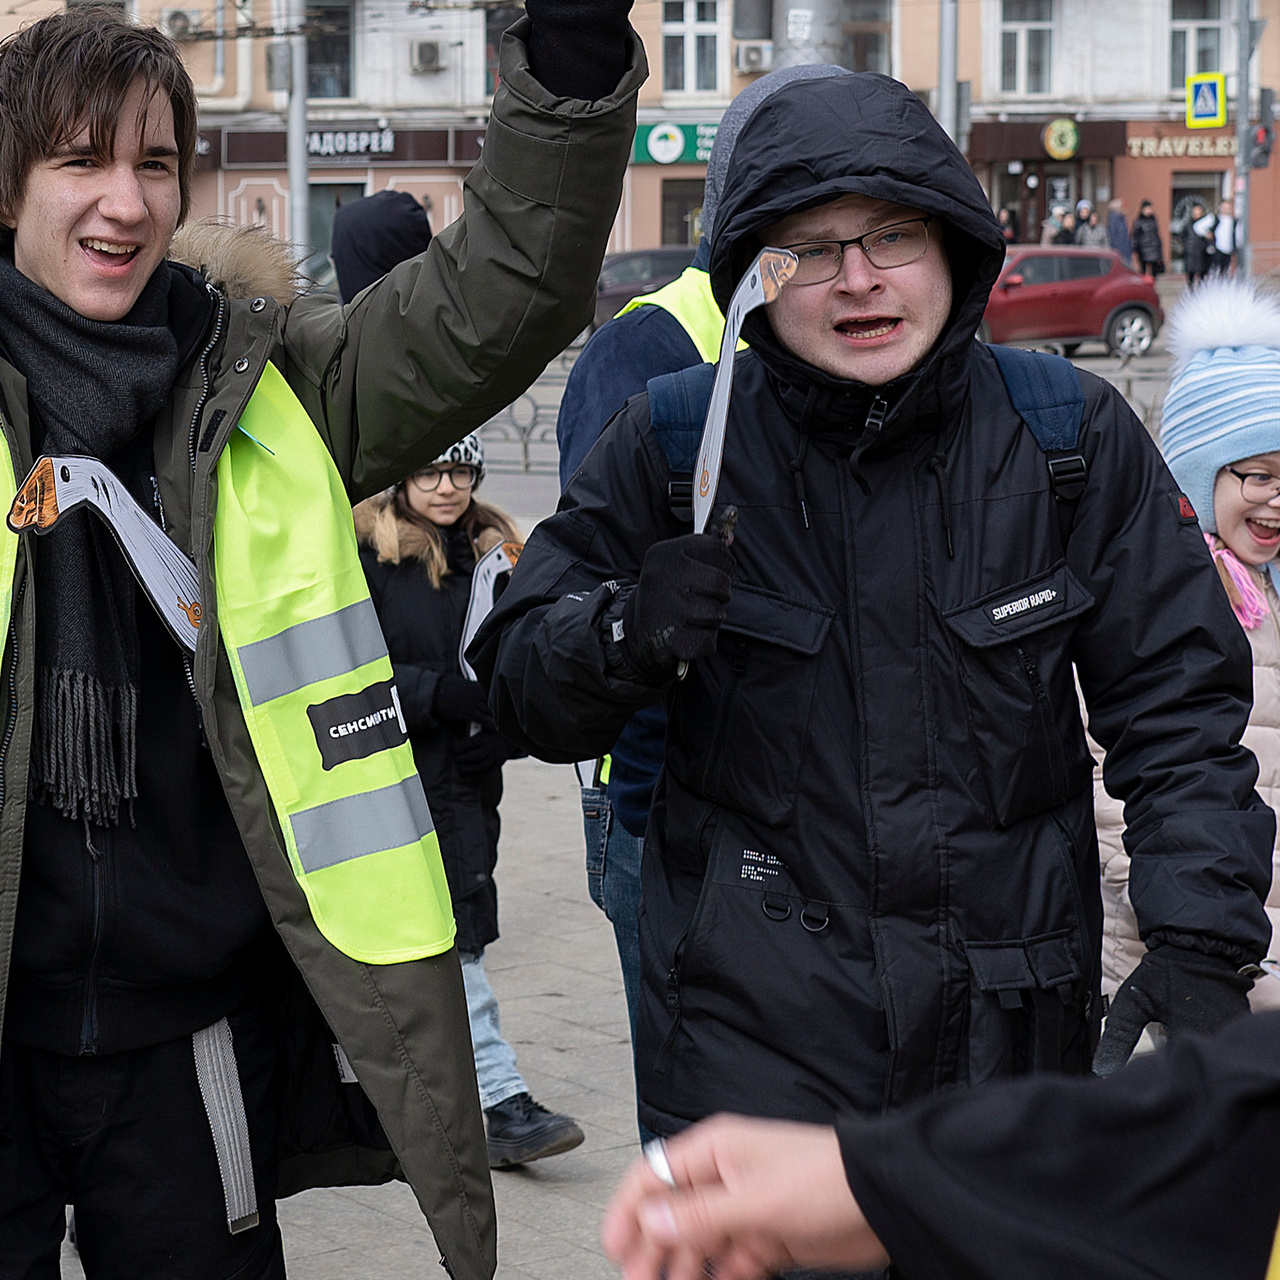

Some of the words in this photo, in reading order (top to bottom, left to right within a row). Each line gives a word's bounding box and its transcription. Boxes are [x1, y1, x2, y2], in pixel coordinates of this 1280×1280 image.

[305, 128, 395, 156] АДОБРЕЙ
[991, 597, 1031, 621] SUPERIOR
[1028, 588, 1058, 608] RAPID+
